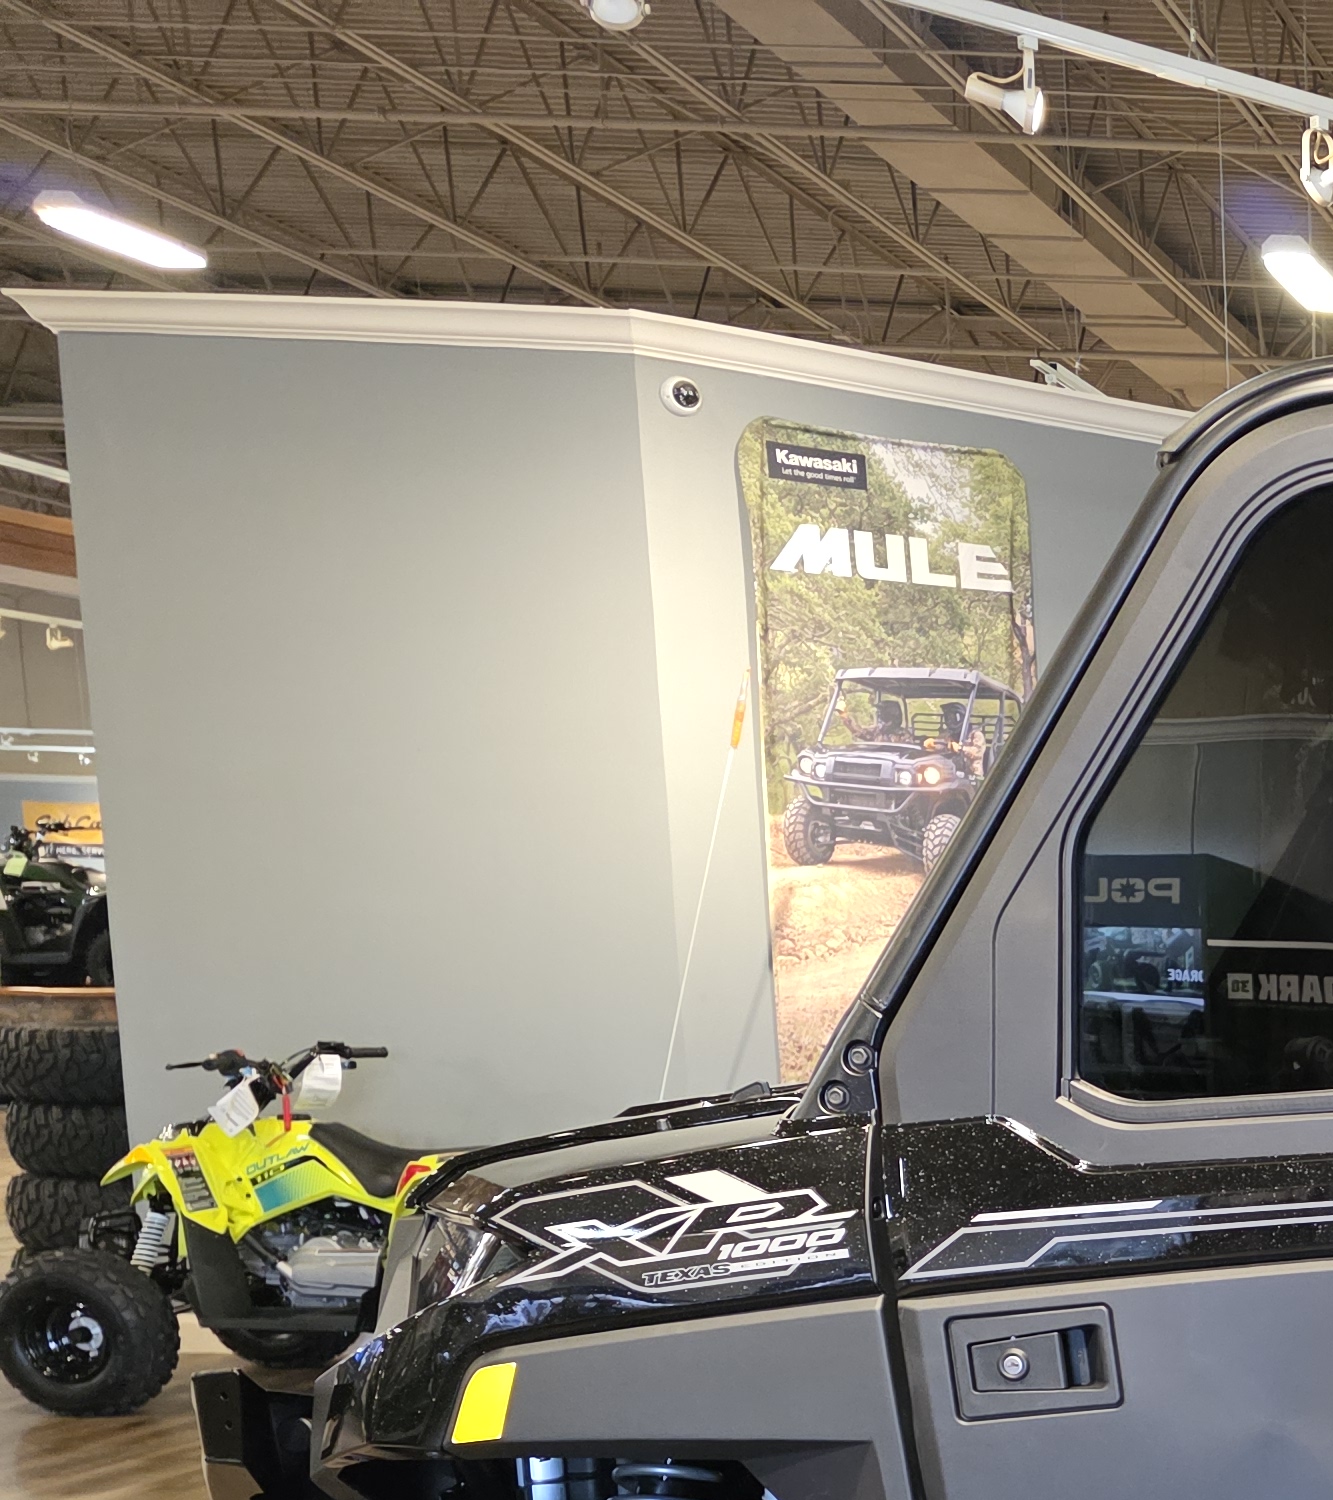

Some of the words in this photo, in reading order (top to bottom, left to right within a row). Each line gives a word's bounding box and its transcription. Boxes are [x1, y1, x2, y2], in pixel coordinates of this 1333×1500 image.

[775, 448, 858, 474] Kawasaki
[781, 467, 792, 475] Let
[793, 469, 805, 477] the
[806, 471, 823, 480] good
[824, 474, 842, 482] times
[769, 523, 1014, 593] MULE
[246, 1142, 310, 1176] OUTLAW
[717, 1228, 847, 1261] 1000
[642, 1263, 731, 1287] TEXAS
[740, 1253, 837, 1269] EDITION
